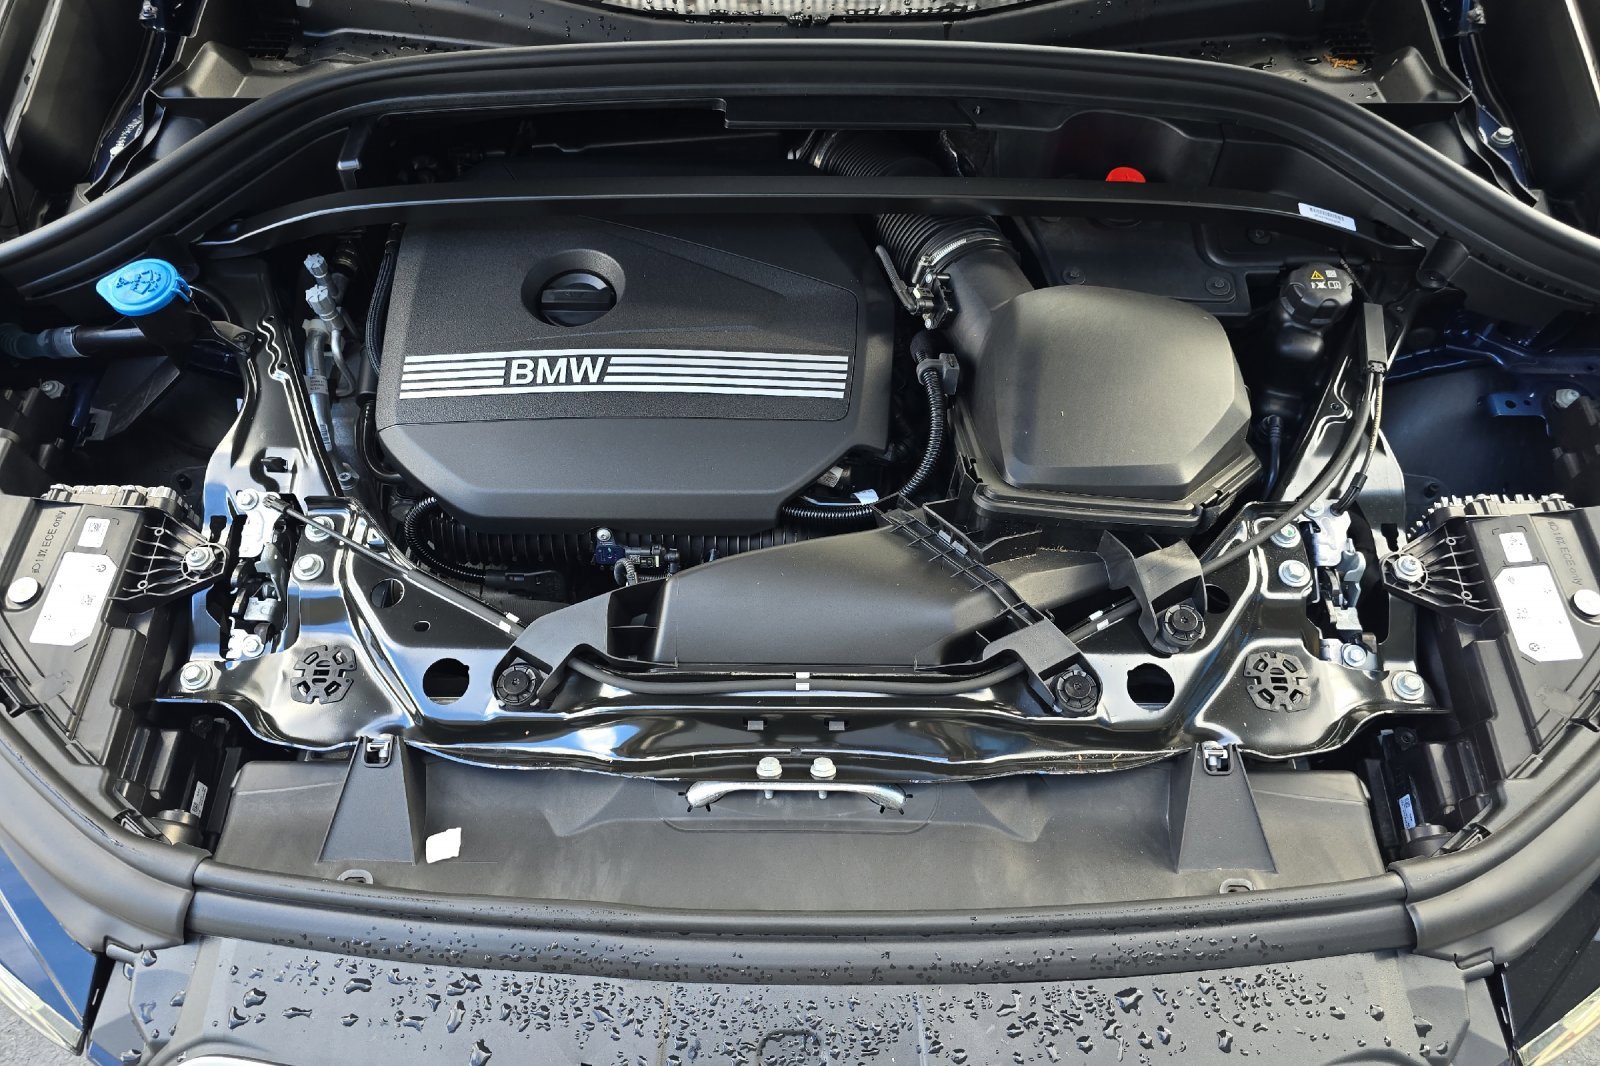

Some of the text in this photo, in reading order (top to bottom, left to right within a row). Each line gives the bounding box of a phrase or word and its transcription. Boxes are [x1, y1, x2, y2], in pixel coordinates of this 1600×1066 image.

[509, 356, 605, 385] BMW
[41, 529, 58, 548] ECE
[53, 510, 67, 528] only
[1560, 546, 1577, 566] ECE
[1568, 567, 1582, 586] only
